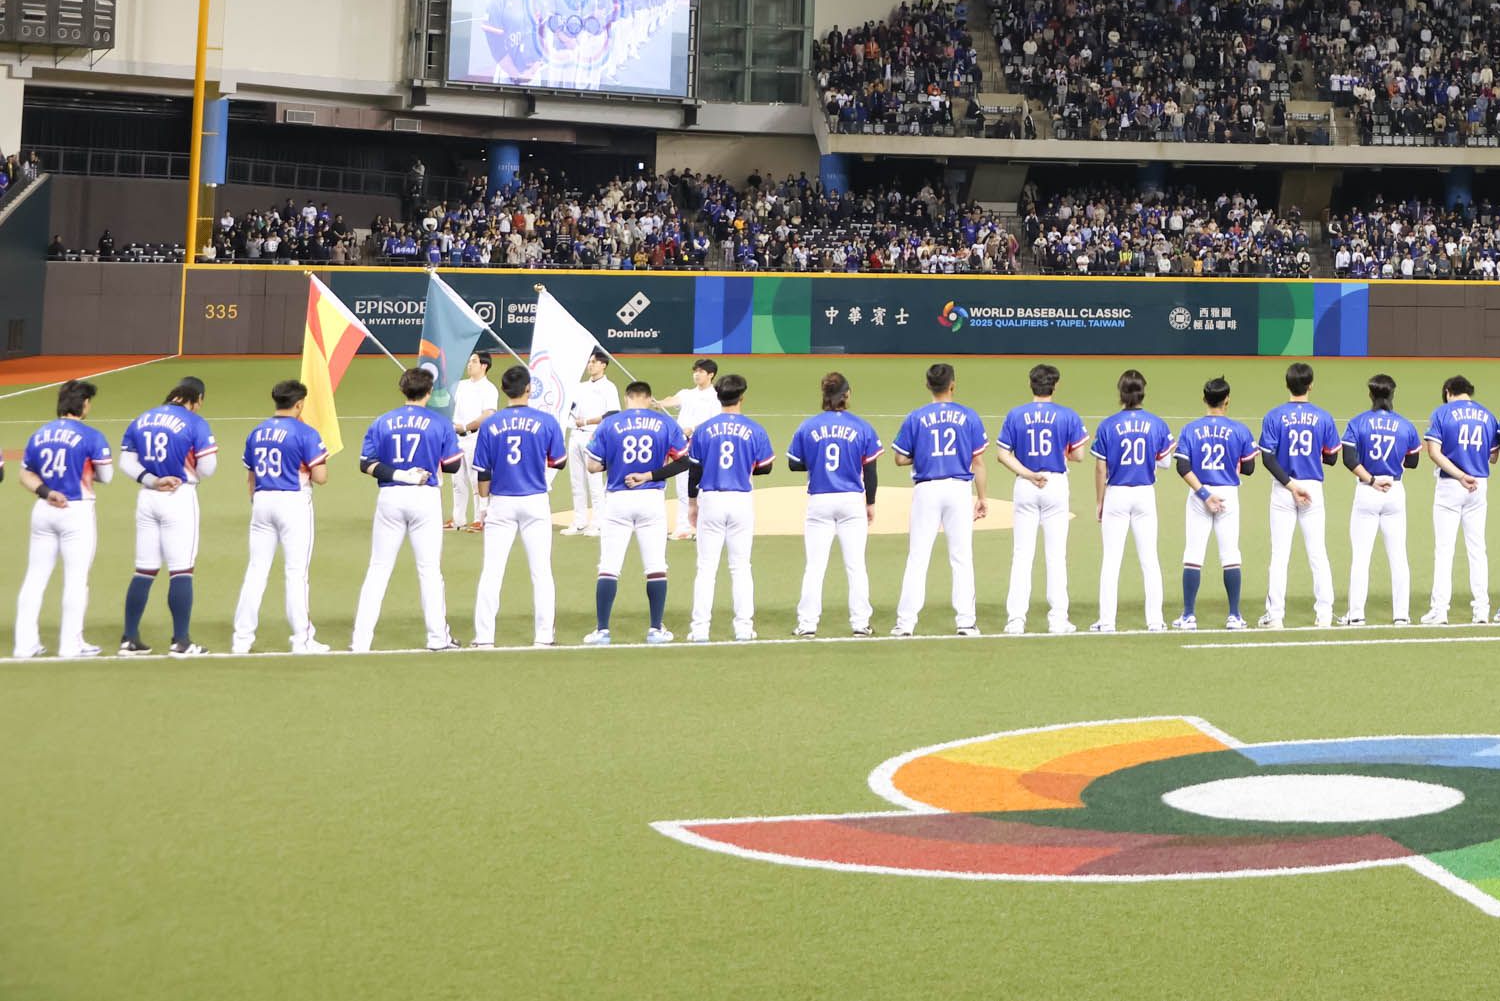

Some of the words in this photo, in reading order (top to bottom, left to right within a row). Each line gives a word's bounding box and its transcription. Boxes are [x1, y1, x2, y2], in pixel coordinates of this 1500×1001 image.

[205, 304, 238, 319] 335
[825, 306, 909, 325] 中華賓士
[969, 307, 1015, 318] WORLD
[1017, 307, 1078, 318] BASEBALL
[1079, 308, 1132, 319] CLASSIC
[970, 319, 993, 327] 2025
[995, 319, 1049, 328] QUALIFIERS
[1088, 319, 1125, 328] TAIWAN
[607, 328, 659, 338] Domino's
[386, 415, 431, 430] Y.C.KAO
[613, 417, 663, 434] C.J.SUNG
[706, 422, 753, 440] T.Y.TSENG
[1368, 417, 1400, 433] Y.C.LU
[143, 431, 168, 463] 18
[392, 433, 421, 464] 17
[506, 435, 522, 465] 3
[622, 434, 653, 464] 88
[930, 427, 957, 457] 12
[1026, 428, 1053, 457] 16
[1120, 437, 1146, 466] 20
[1288, 429, 1313, 457] 29
[1369, 434, 1396, 461] 37
[1458, 423, 1483, 452] 44
[40, 448, 67, 479] 24
[254, 447, 282, 478] 39
[719, 440, 735, 470] 8
[825, 443, 840, 472] 9
[1201, 443, 1225, 470] 22
